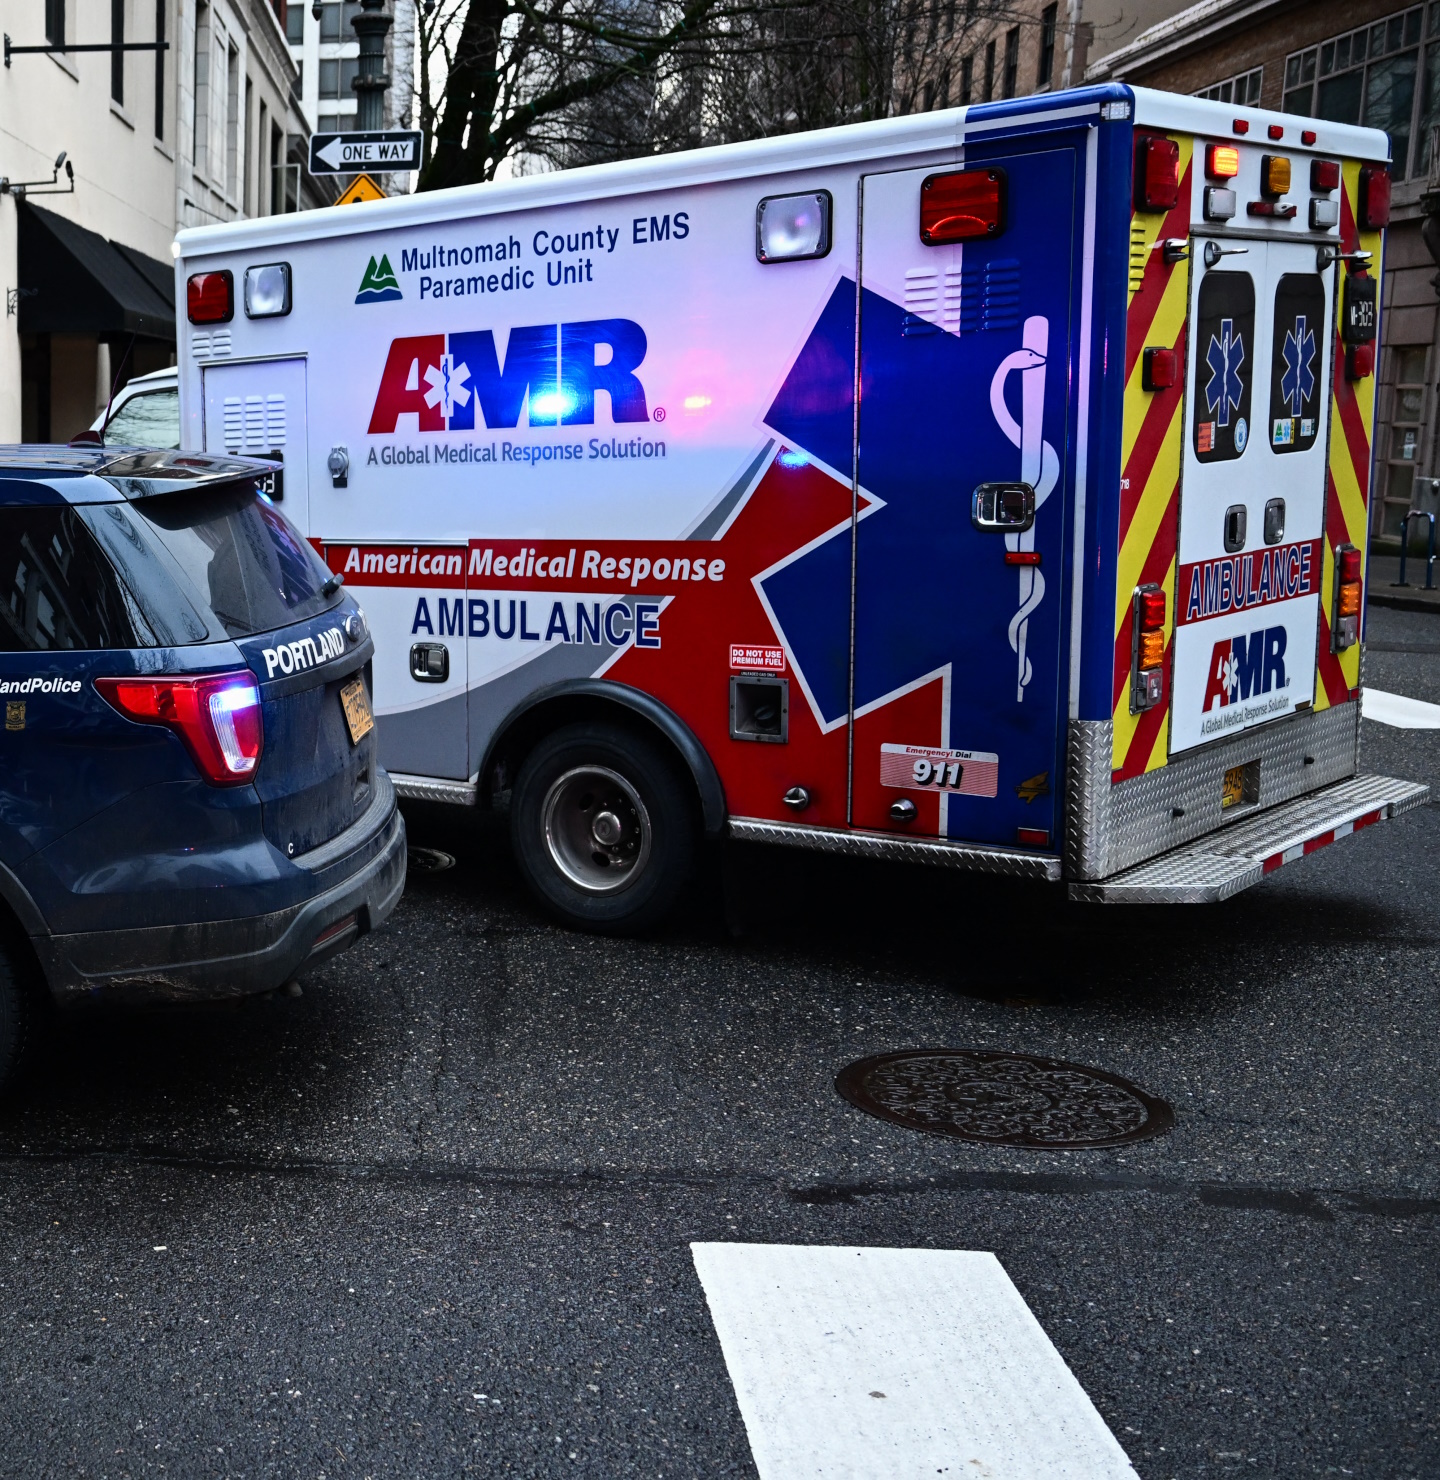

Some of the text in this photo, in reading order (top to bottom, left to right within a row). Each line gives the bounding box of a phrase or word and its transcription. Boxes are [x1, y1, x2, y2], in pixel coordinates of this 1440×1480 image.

[342, 143, 409, 161] ONE WAY
[401, 212, 690, 272] Multnomah County EMS
[420, 258, 593, 300] Paramedic Unit
[367, 318, 650, 434] AMR
[367, 436, 666, 466] A Global Medical Response Solution
[344, 547, 726, 588] American Medical Response
[1186, 543, 1312, 620] AMBULANCE
[411, 597, 661, 648] AMBULANCE
[262, 627, 344, 678] PORTLAND
[732, 649, 782, 659] DO NOT USE
[732, 656, 783, 666] PREMIUM FUEL
[1201, 625, 1288, 714] AMR
[1200, 695, 1289, 736] A Global Medical Response Solution
[905, 747, 972, 759] Emergency! Dial
[912, 759, 964, 789] 911
